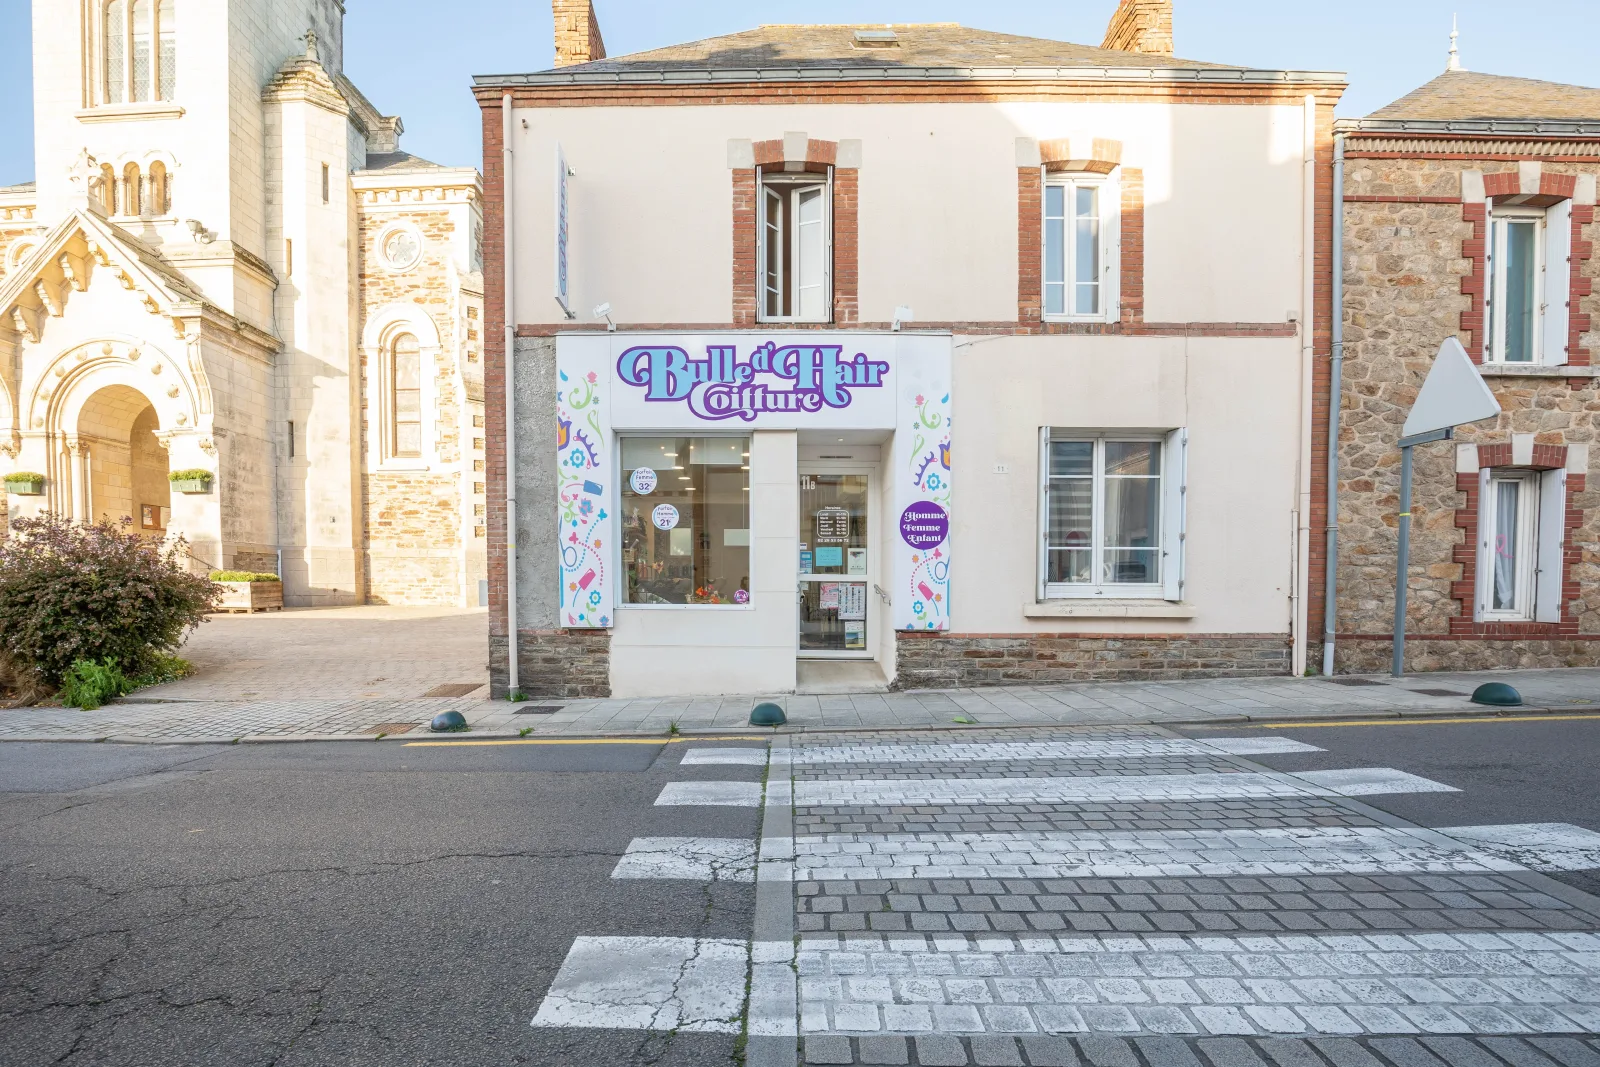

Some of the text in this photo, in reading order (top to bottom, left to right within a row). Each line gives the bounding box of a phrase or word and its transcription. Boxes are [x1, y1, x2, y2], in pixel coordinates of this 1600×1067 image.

[617, 345, 755, 401] Bulle
[687, 381, 823, 421] Coiffure
[904, 511, 946, 522] Homme
[903, 524, 941, 532] Femme
[907, 534, 941, 545] Enfant
